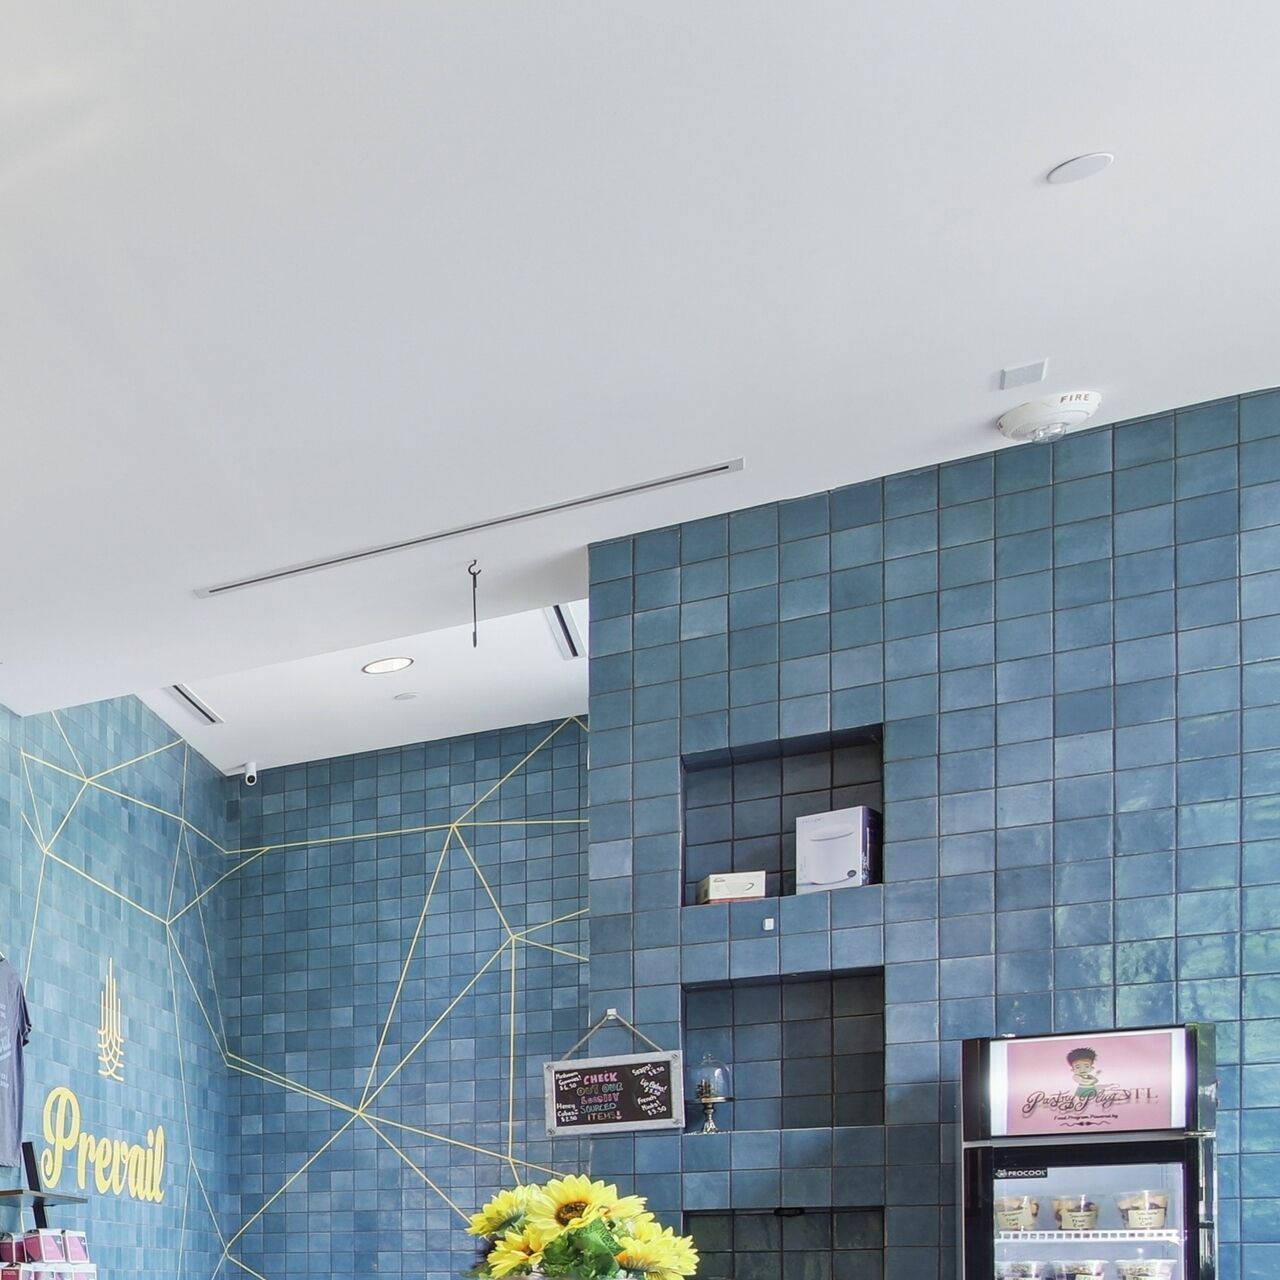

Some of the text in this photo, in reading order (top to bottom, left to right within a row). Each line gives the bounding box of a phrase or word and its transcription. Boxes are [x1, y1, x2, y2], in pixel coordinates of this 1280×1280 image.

[584, 1072, 618, 1085] CHECK
[1022, 1089, 1075, 1114] Pastry
[41, 1086, 165, 1203] Prevail
[1008, 1169, 1044, 1178] PROCOOL
